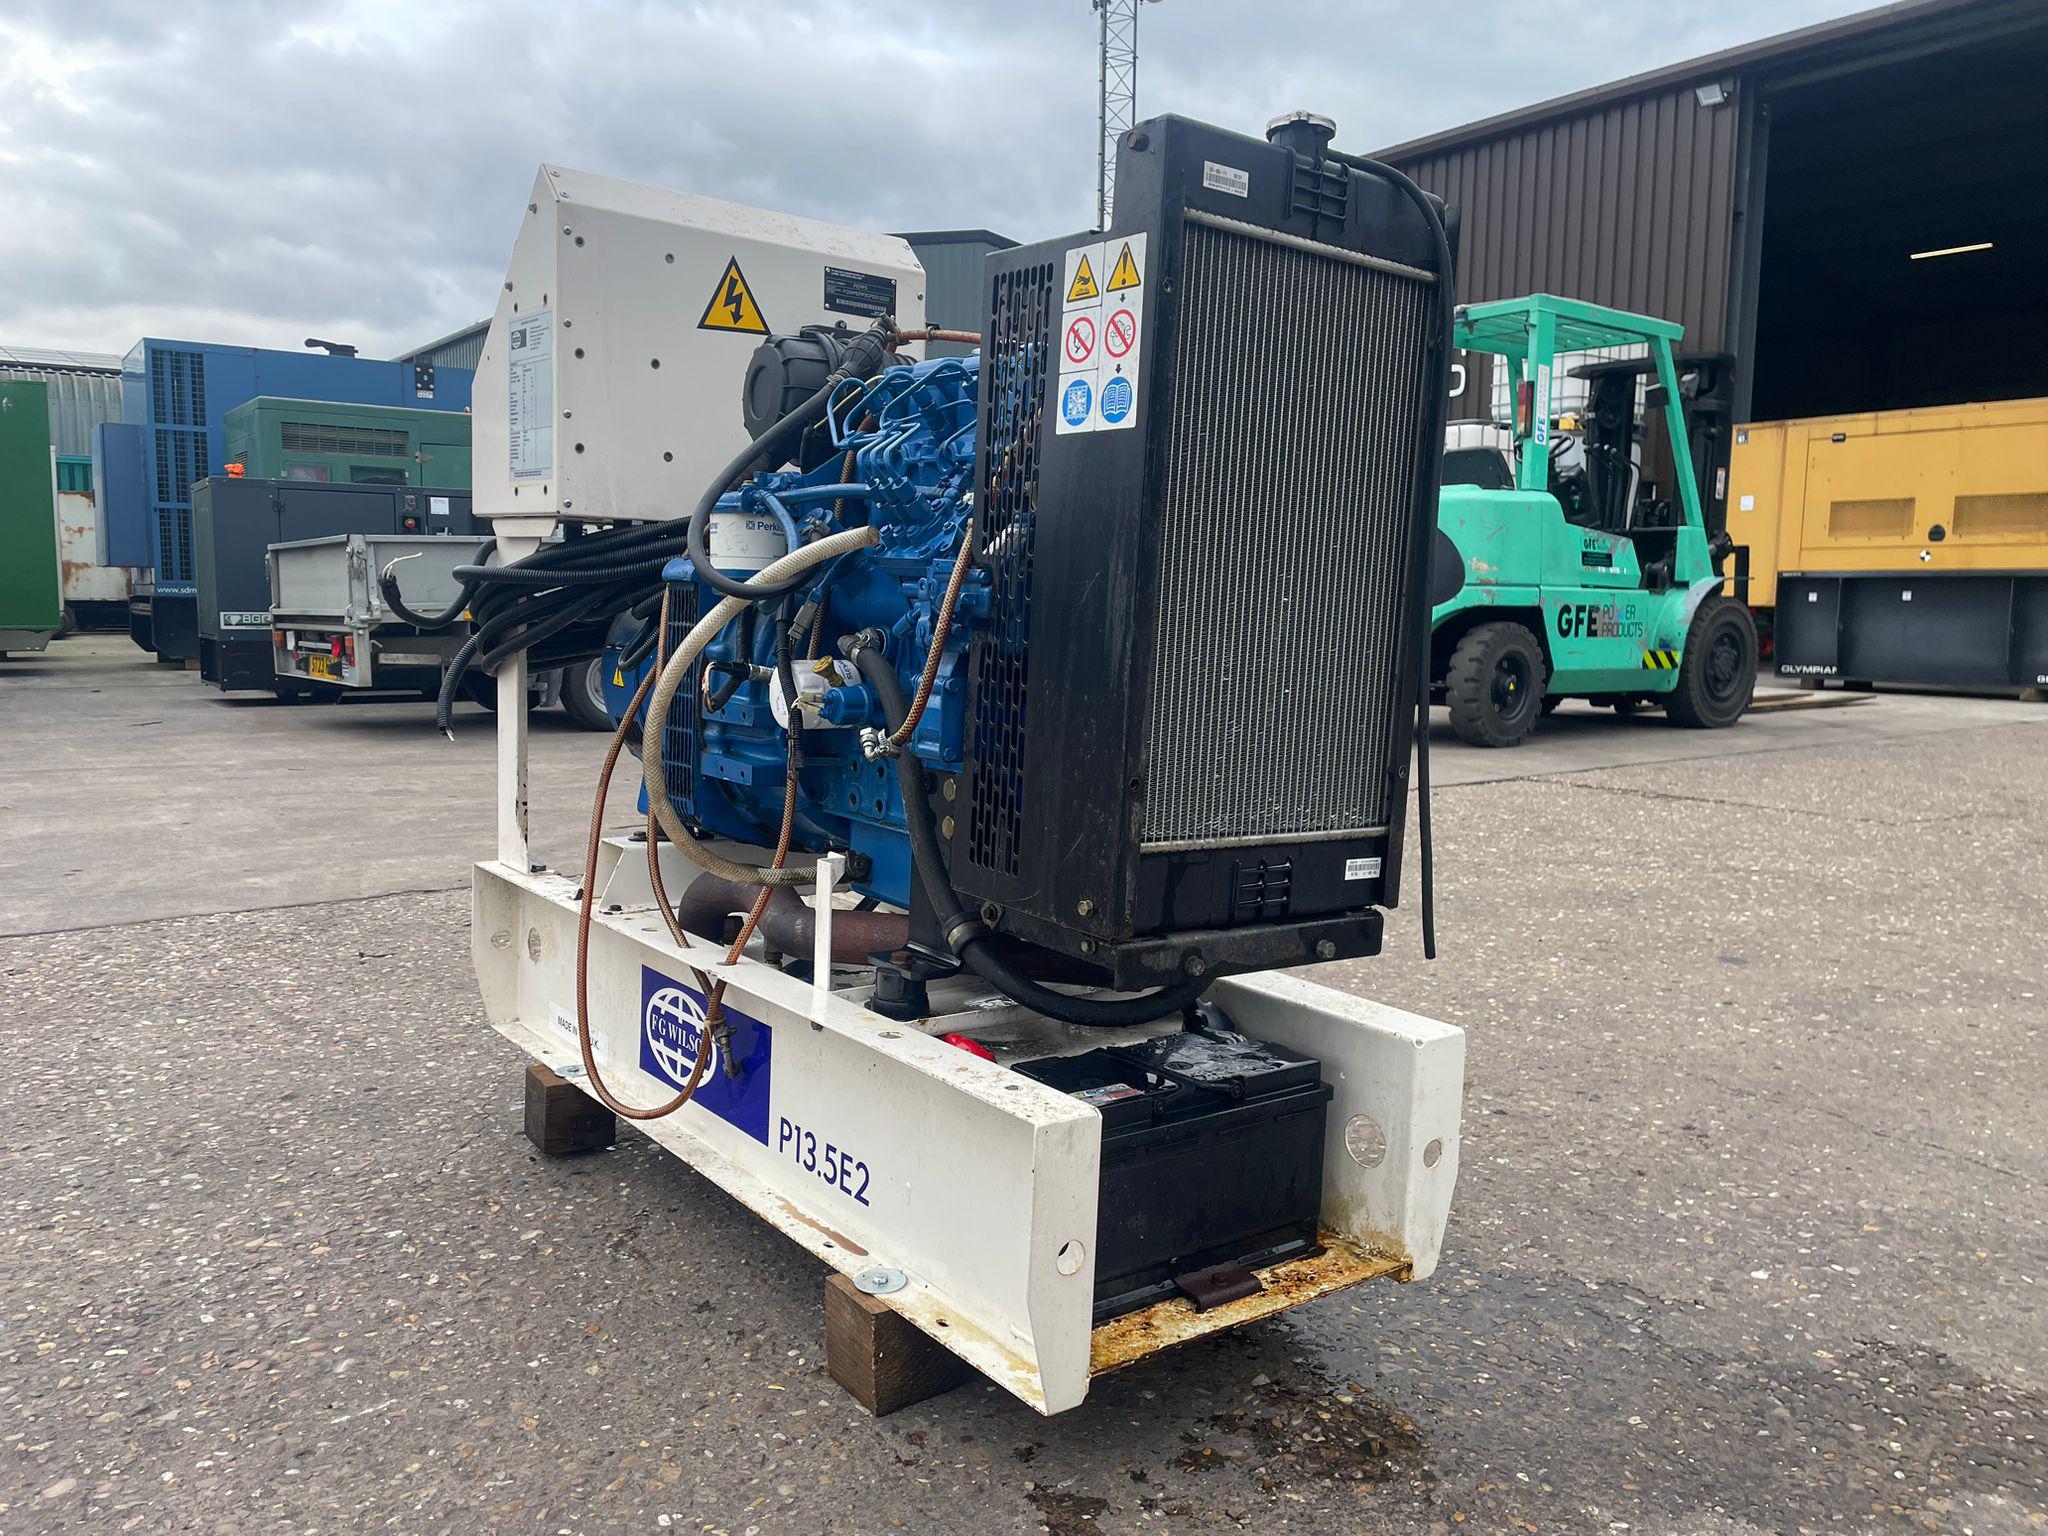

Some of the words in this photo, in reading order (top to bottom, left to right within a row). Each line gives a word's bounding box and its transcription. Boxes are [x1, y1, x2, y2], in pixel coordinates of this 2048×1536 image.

[1558, 604, 1598, 638] GFE
[1601, 621, 1643, 638] PRODUCTS
[667, 1021, 703, 1055] WILSO
[779, 1116, 870, 1207] P13.5E2
